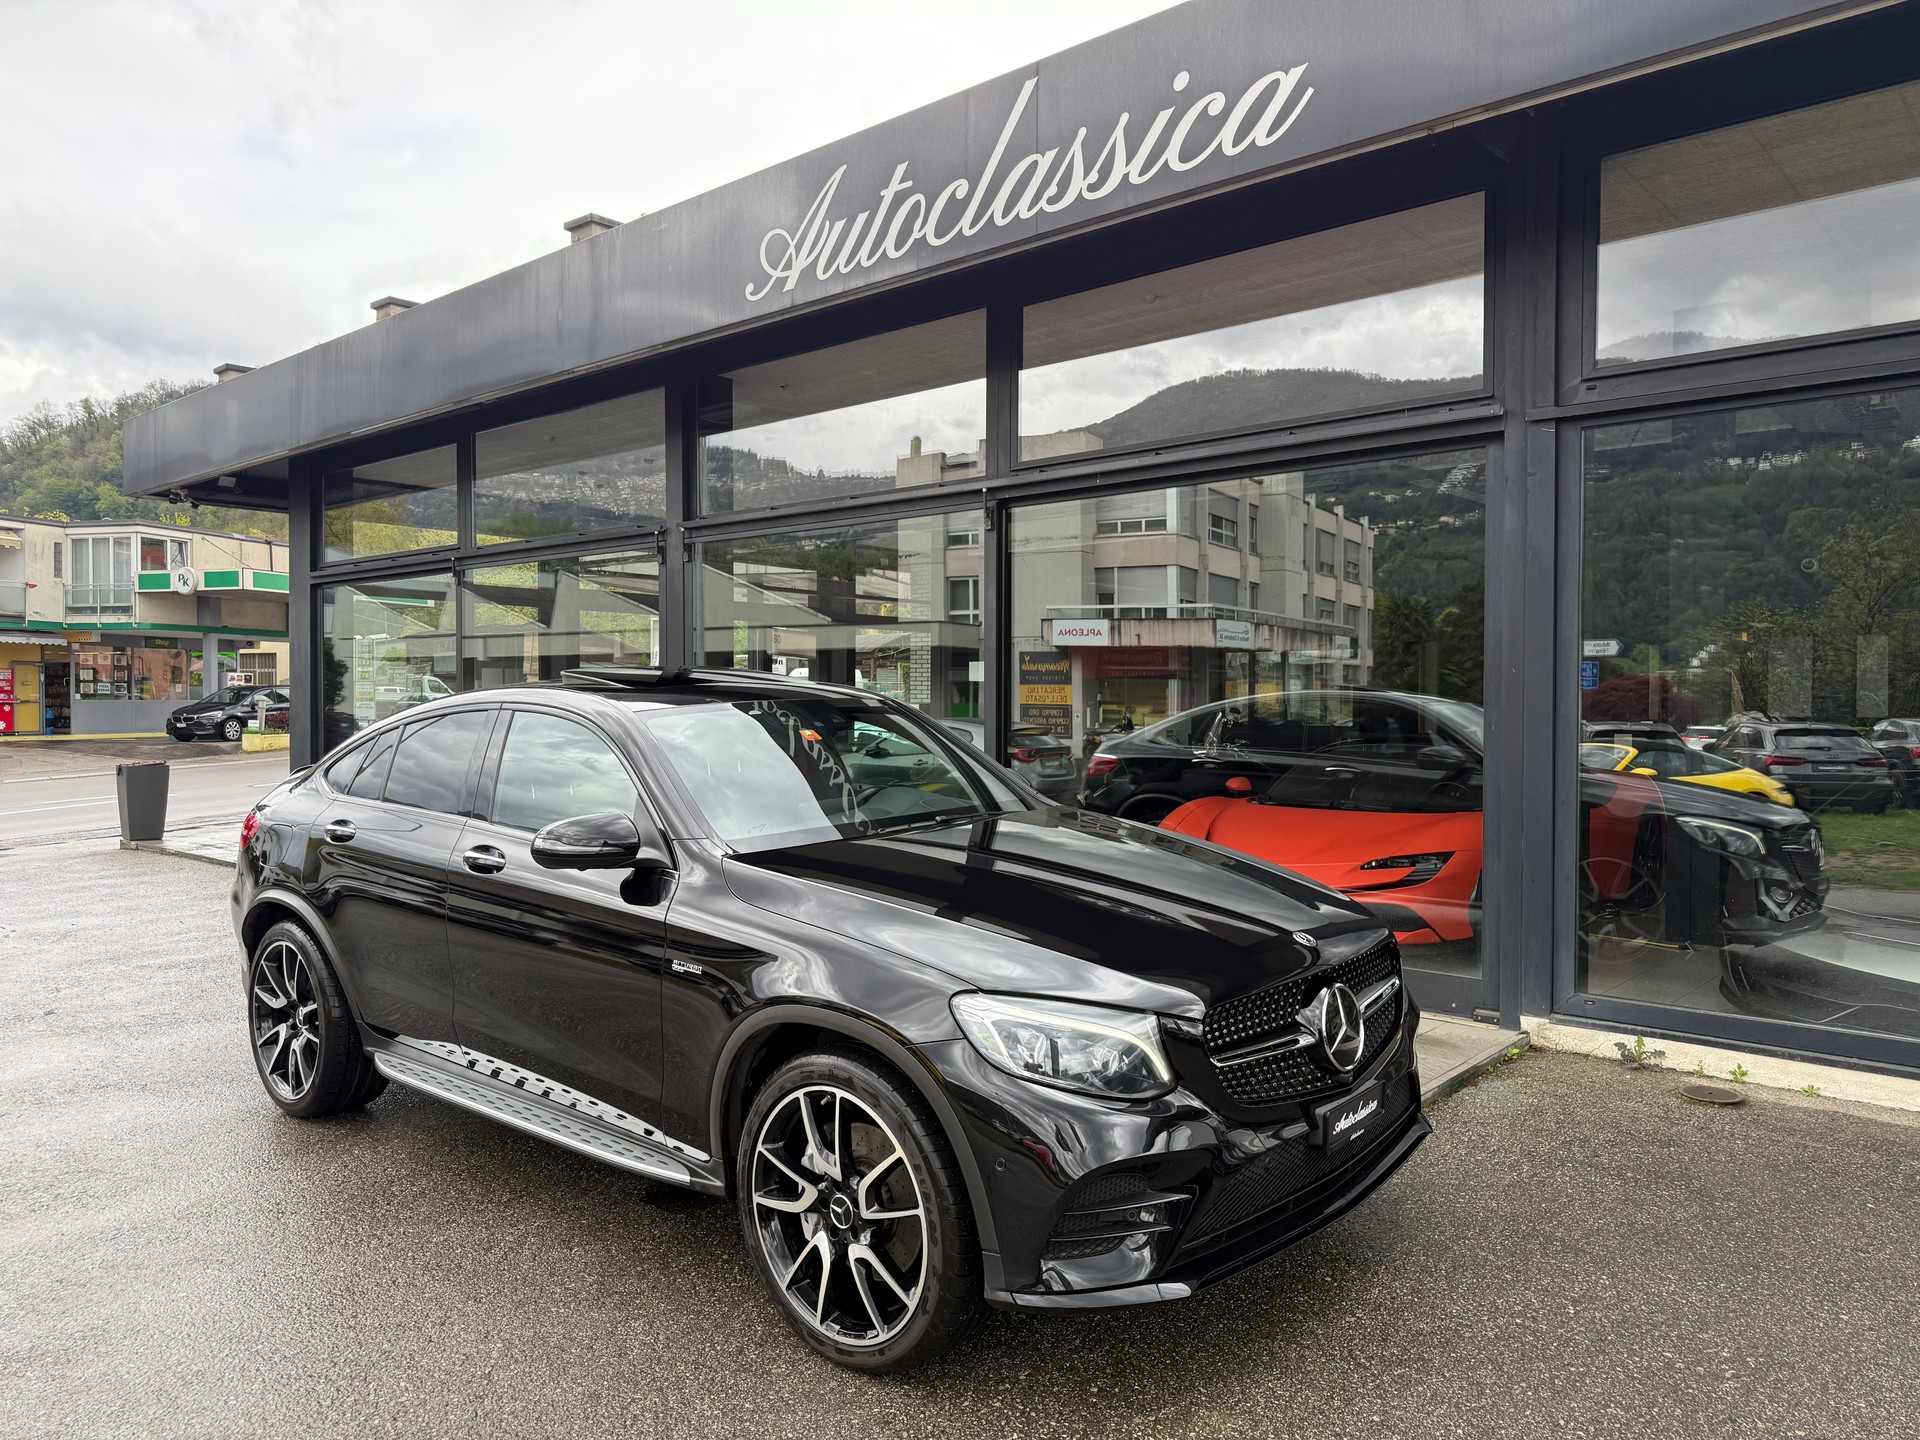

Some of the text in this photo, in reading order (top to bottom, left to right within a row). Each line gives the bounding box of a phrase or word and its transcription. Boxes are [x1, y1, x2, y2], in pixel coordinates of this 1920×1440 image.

[744, 62, 1315, 301] Autoclassica
[178, 573, 190, 587] PK
[155, 637, 170, 646] Shop
[1332, 1099, 1379, 1135] Autoclassica
